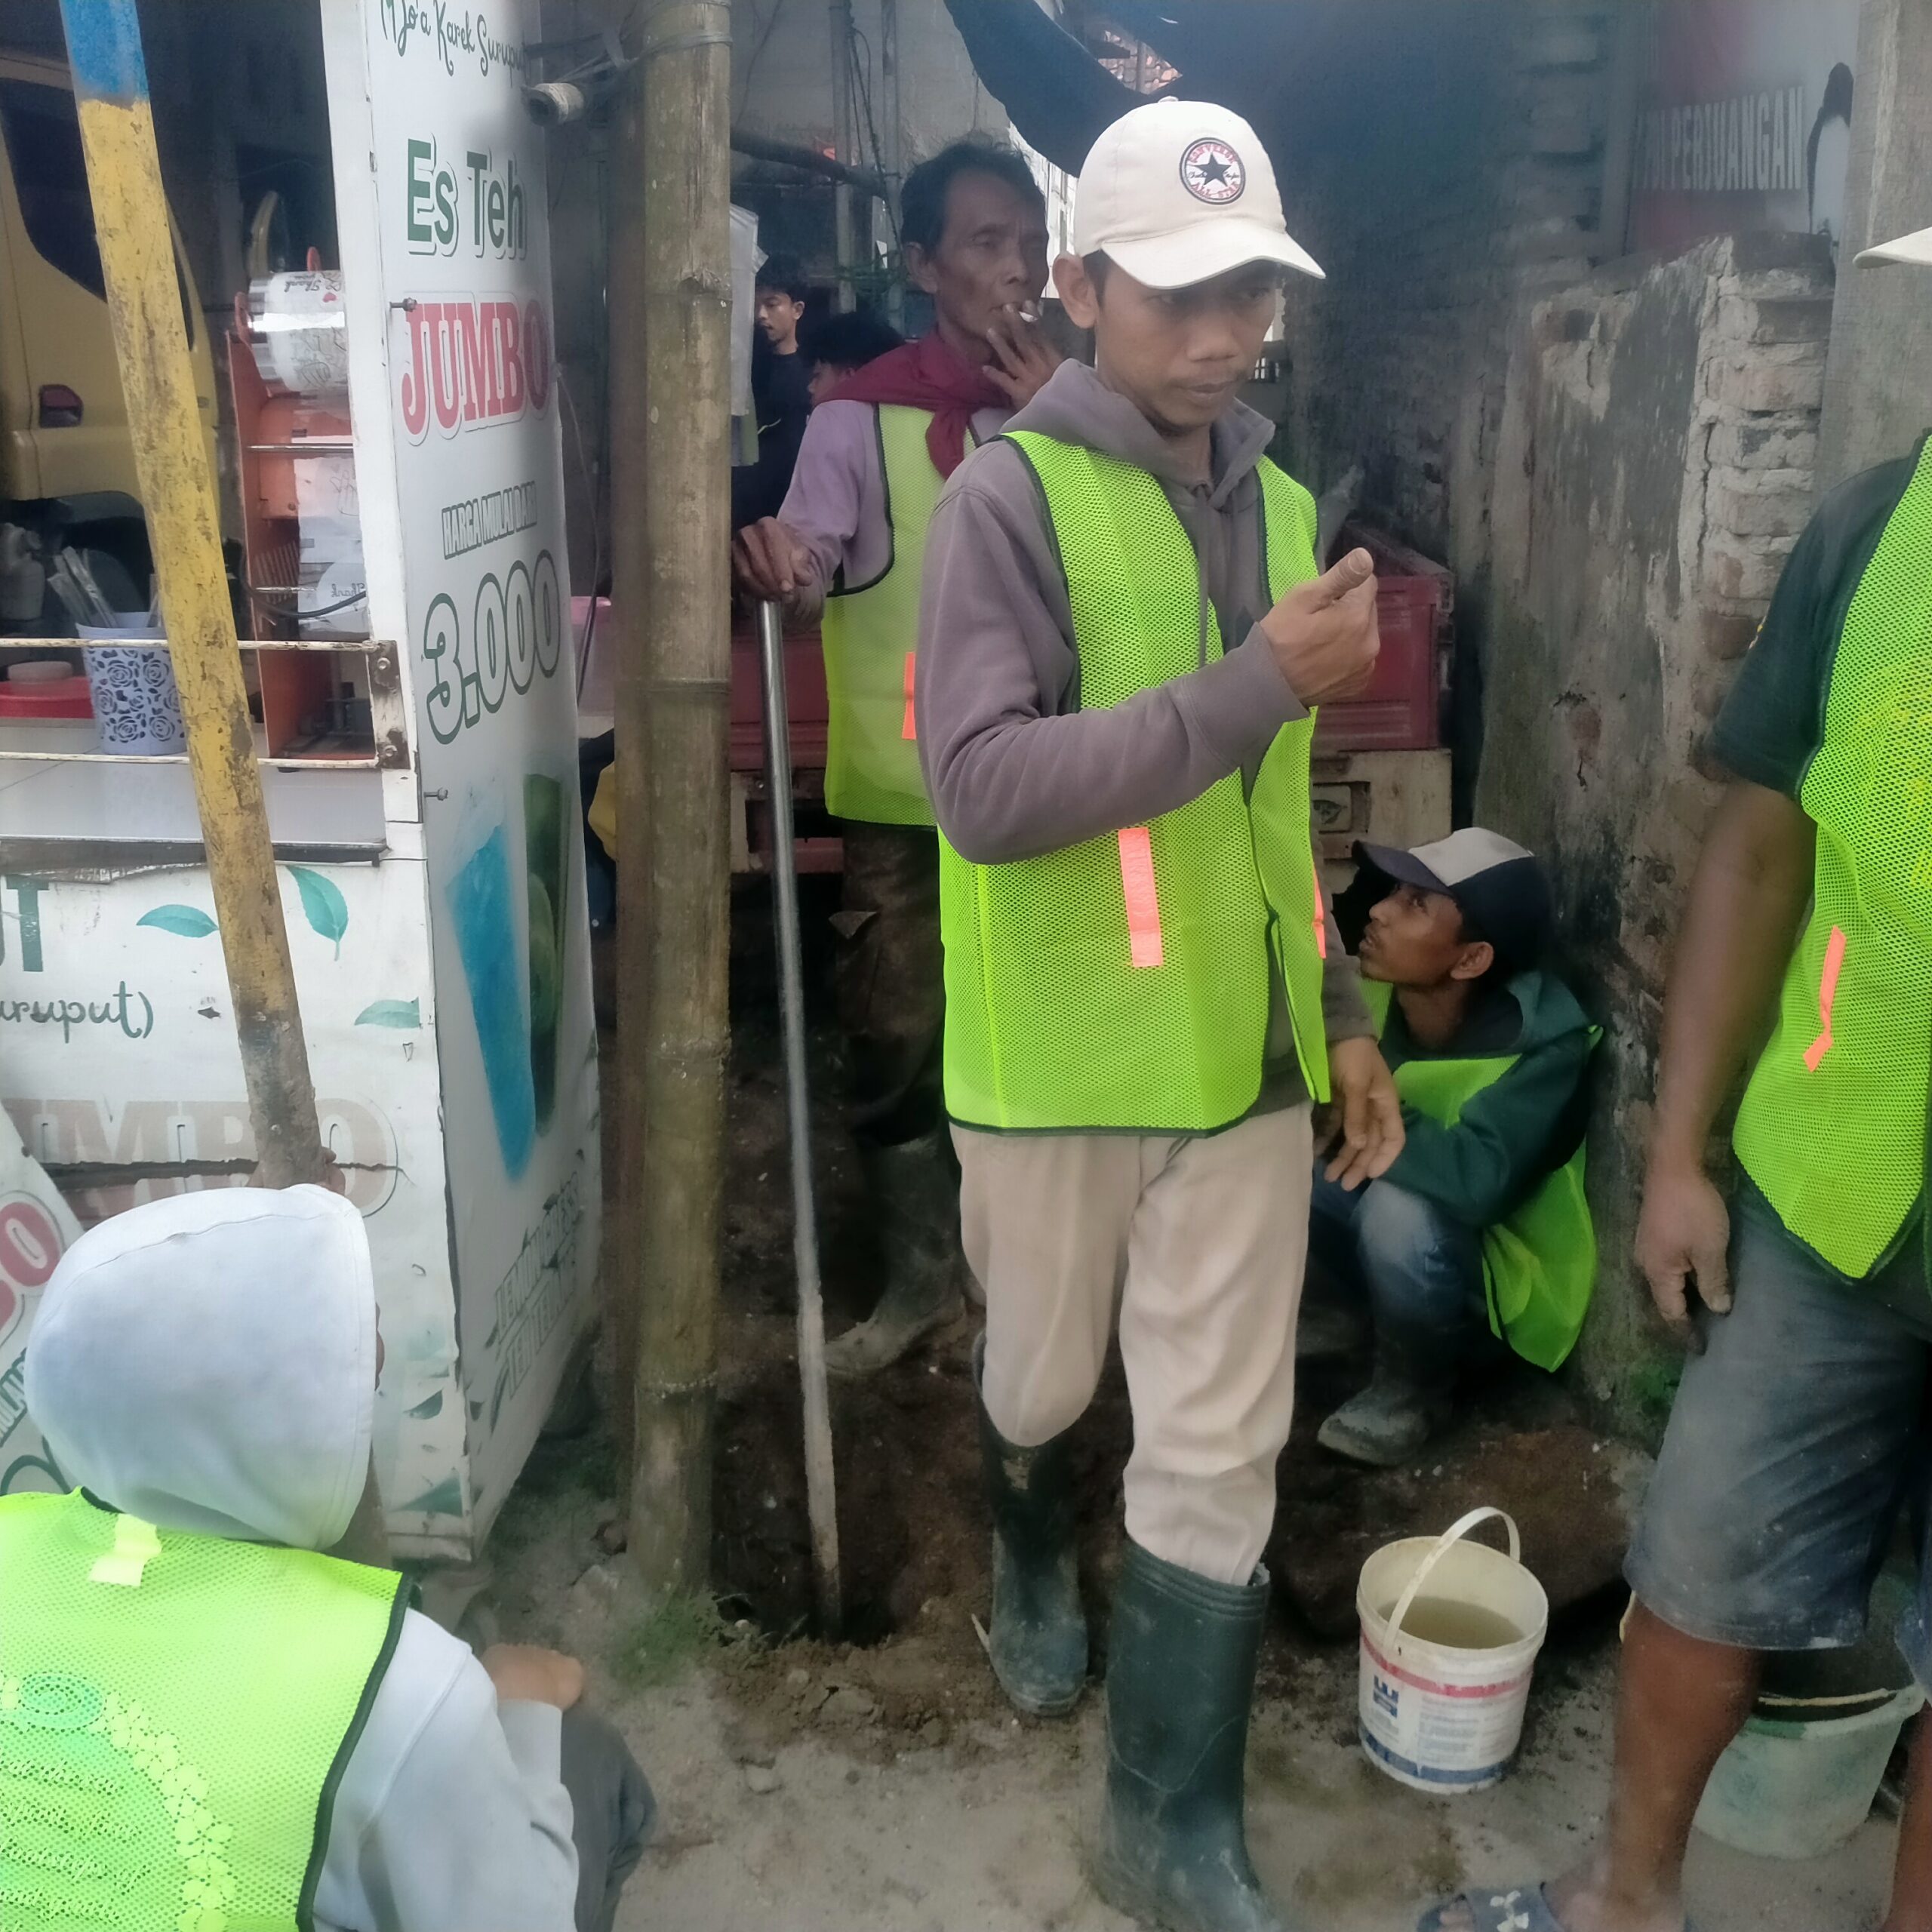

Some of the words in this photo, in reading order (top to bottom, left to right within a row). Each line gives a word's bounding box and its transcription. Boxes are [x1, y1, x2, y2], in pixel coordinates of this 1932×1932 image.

[408, 136, 457, 257] Es
[466, 149, 527, 258] Teh
[401, 297, 552, 439] JUMBO
[441, 498, 482, 560] HARGA
[481, 491, 515, 545] MULAI
[424, 549, 561, 744] 3.000
